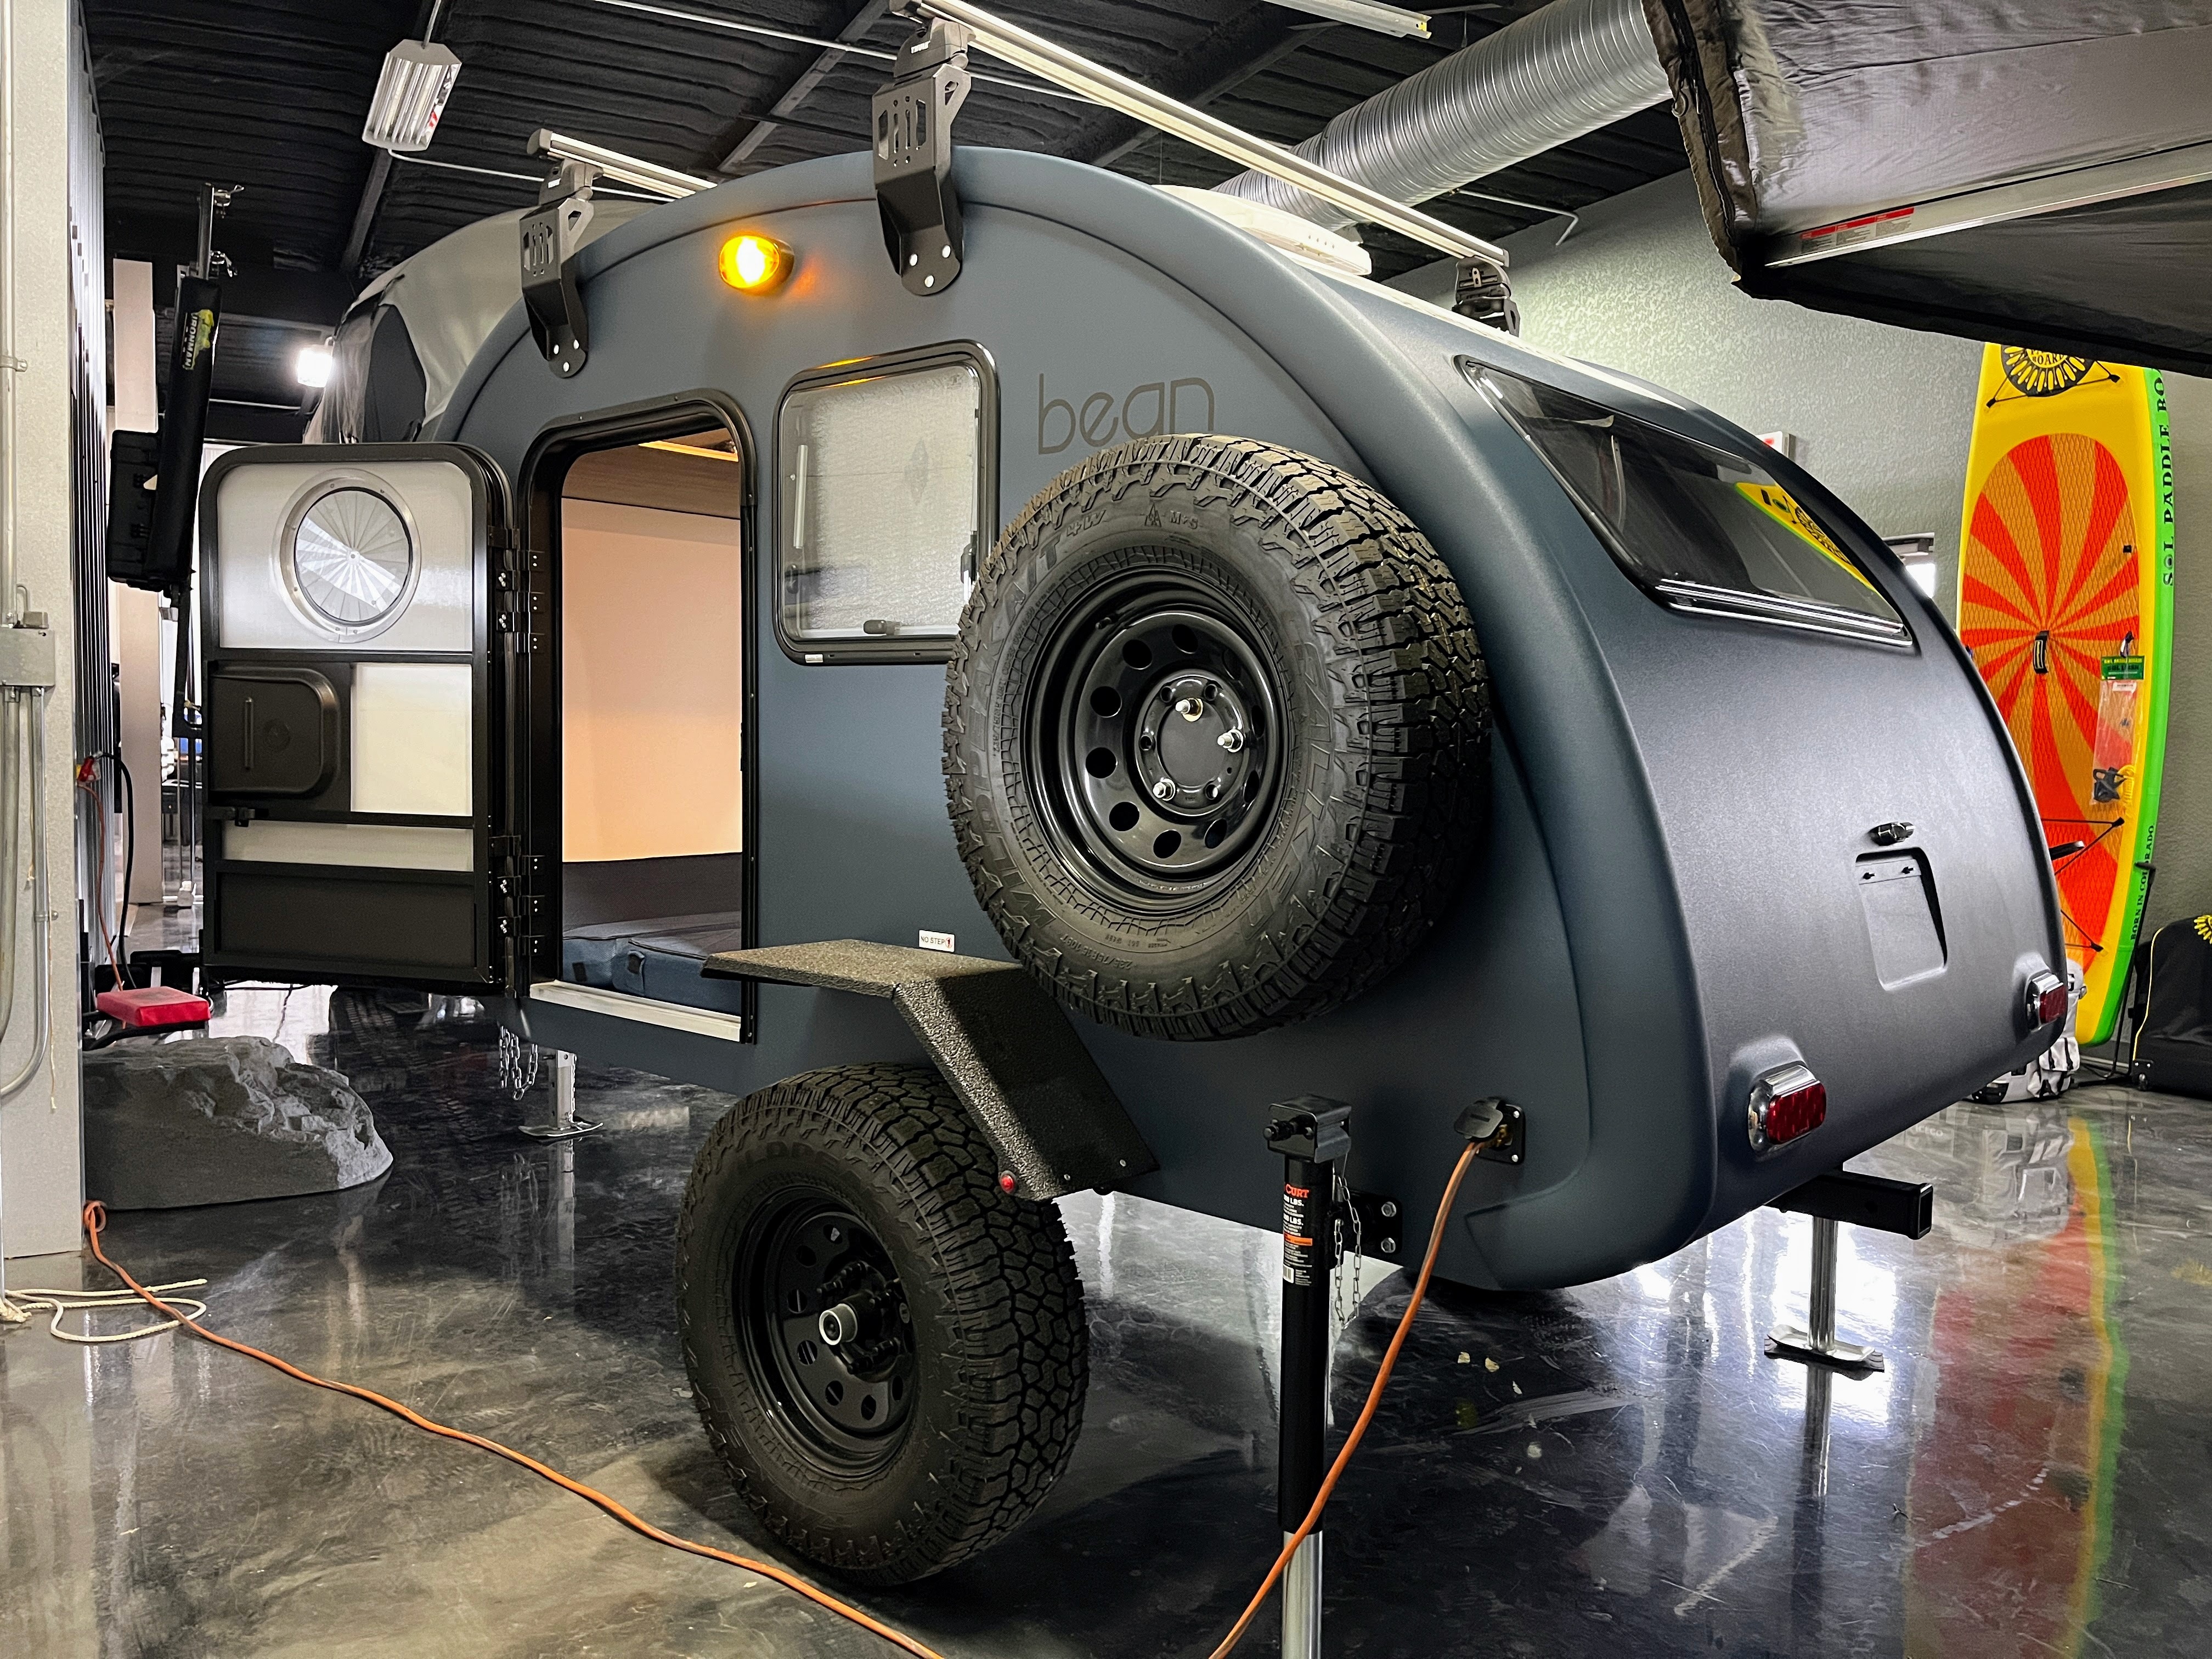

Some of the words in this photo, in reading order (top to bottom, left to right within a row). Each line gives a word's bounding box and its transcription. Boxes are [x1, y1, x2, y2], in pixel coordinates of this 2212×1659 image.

[185, 315, 198, 366] IRONMAN
[1039, 373, 1215, 455] bean
[2160, 425, 2174, 524] PADDLE
[2163, 535, 2174, 586] SOL
[2131, 909, 2141, 940] BORN
[2137, 895, 2143, 906] IN
[2140, 825, 2154, 891] COLRADO
[1285, 1183, 1309, 1198] CURT
[1290, 1197, 1304, 1206] LBS.
[1289, 1216, 1304, 1226] LBS.
